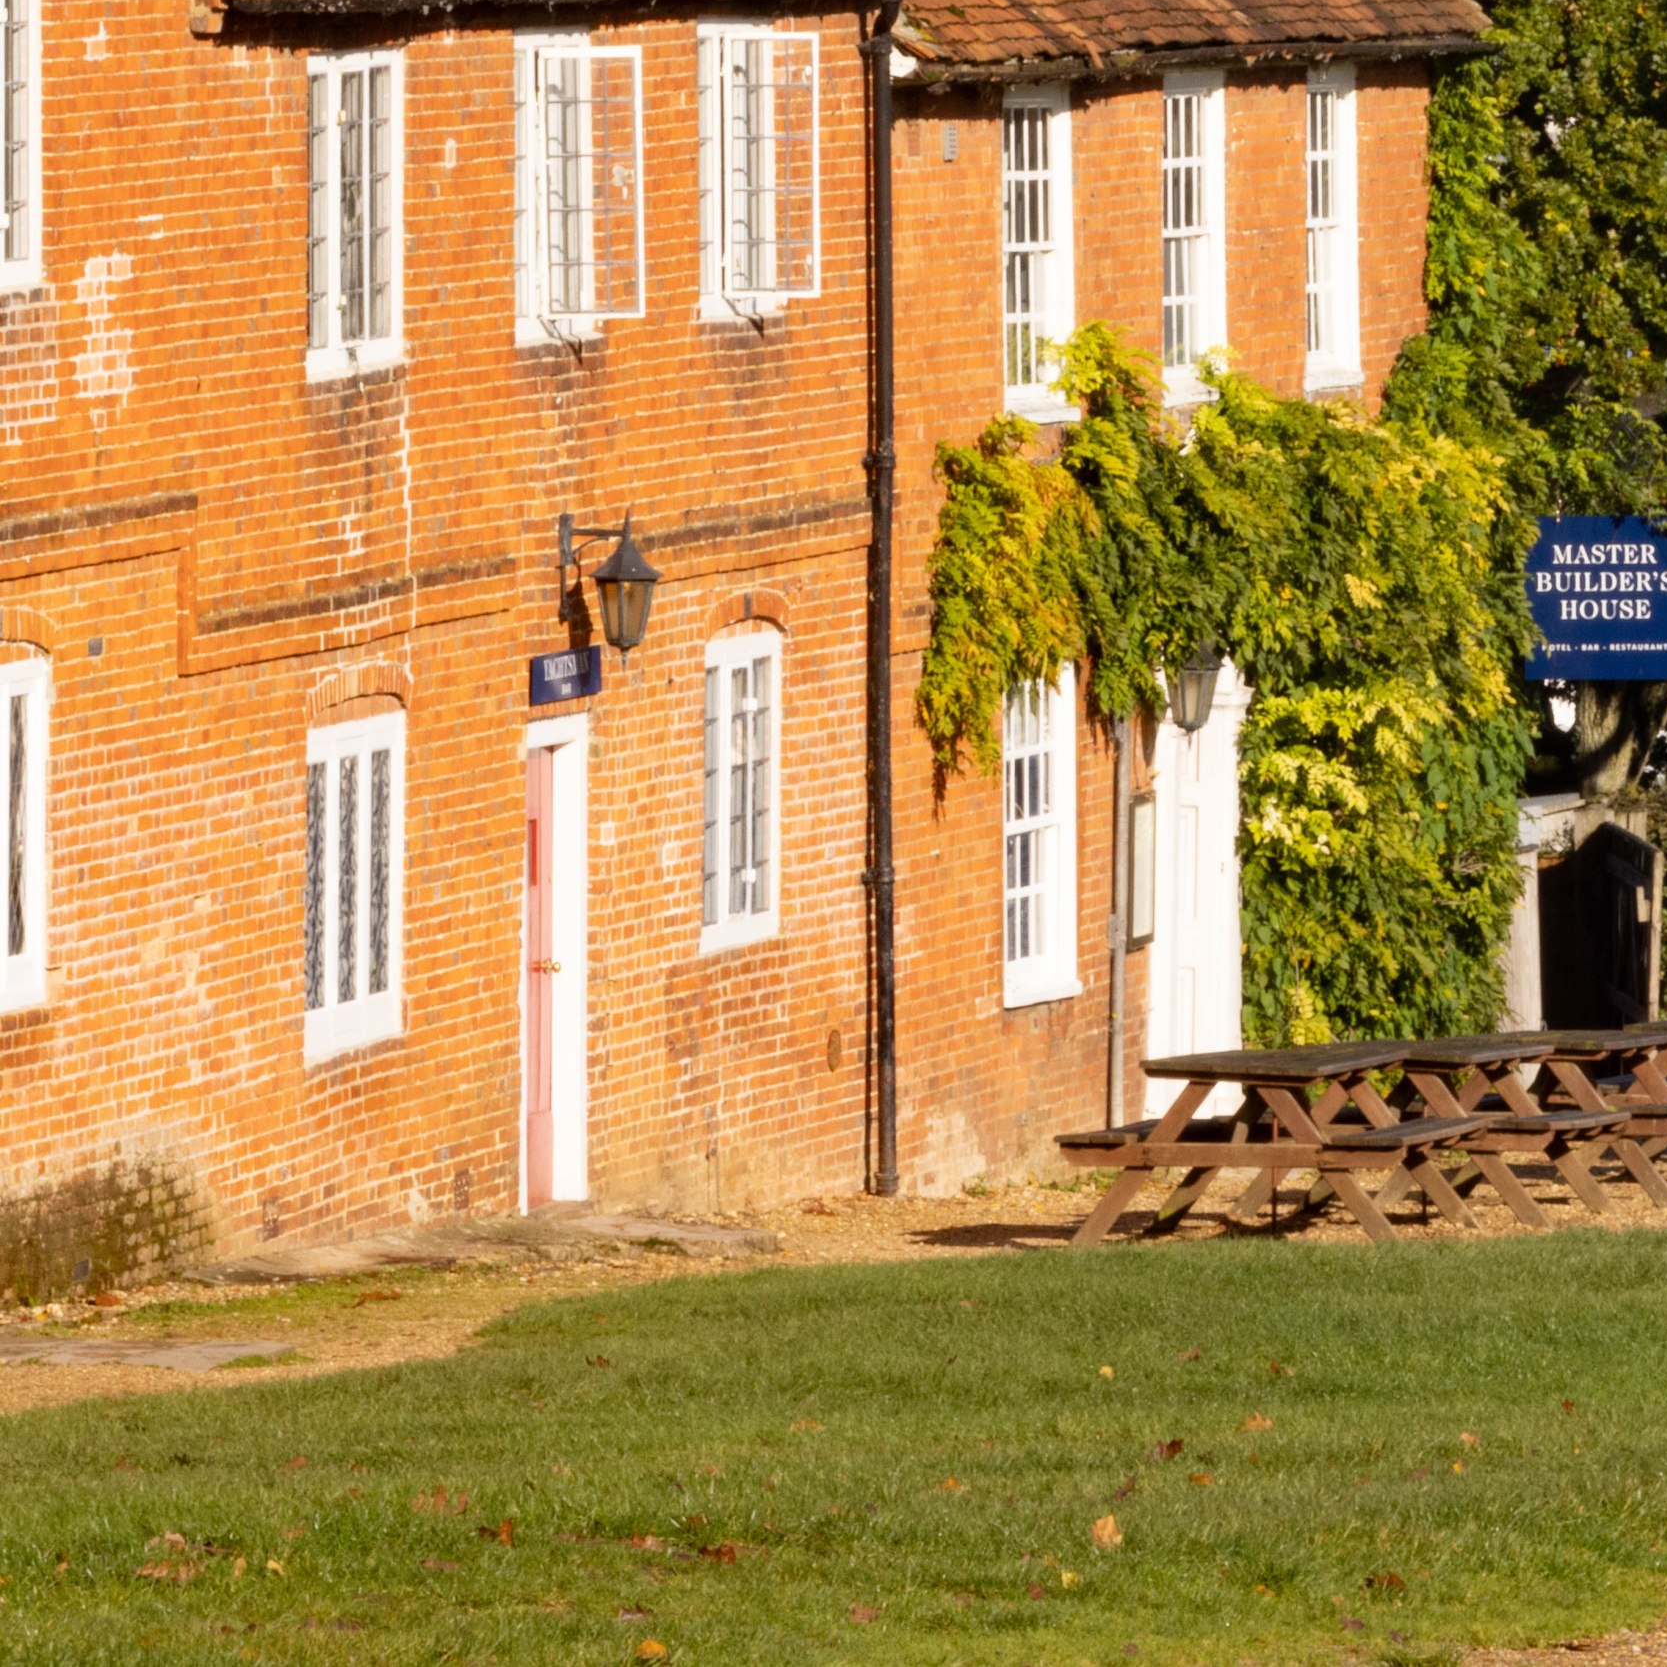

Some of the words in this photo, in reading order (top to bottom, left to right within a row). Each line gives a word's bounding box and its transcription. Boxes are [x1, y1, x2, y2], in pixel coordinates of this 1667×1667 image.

[1552, 544, 1658, 565] MASTER
[1560, 599, 1652, 620] HOUSE
[1581, 643, 1600, 651] BAR
